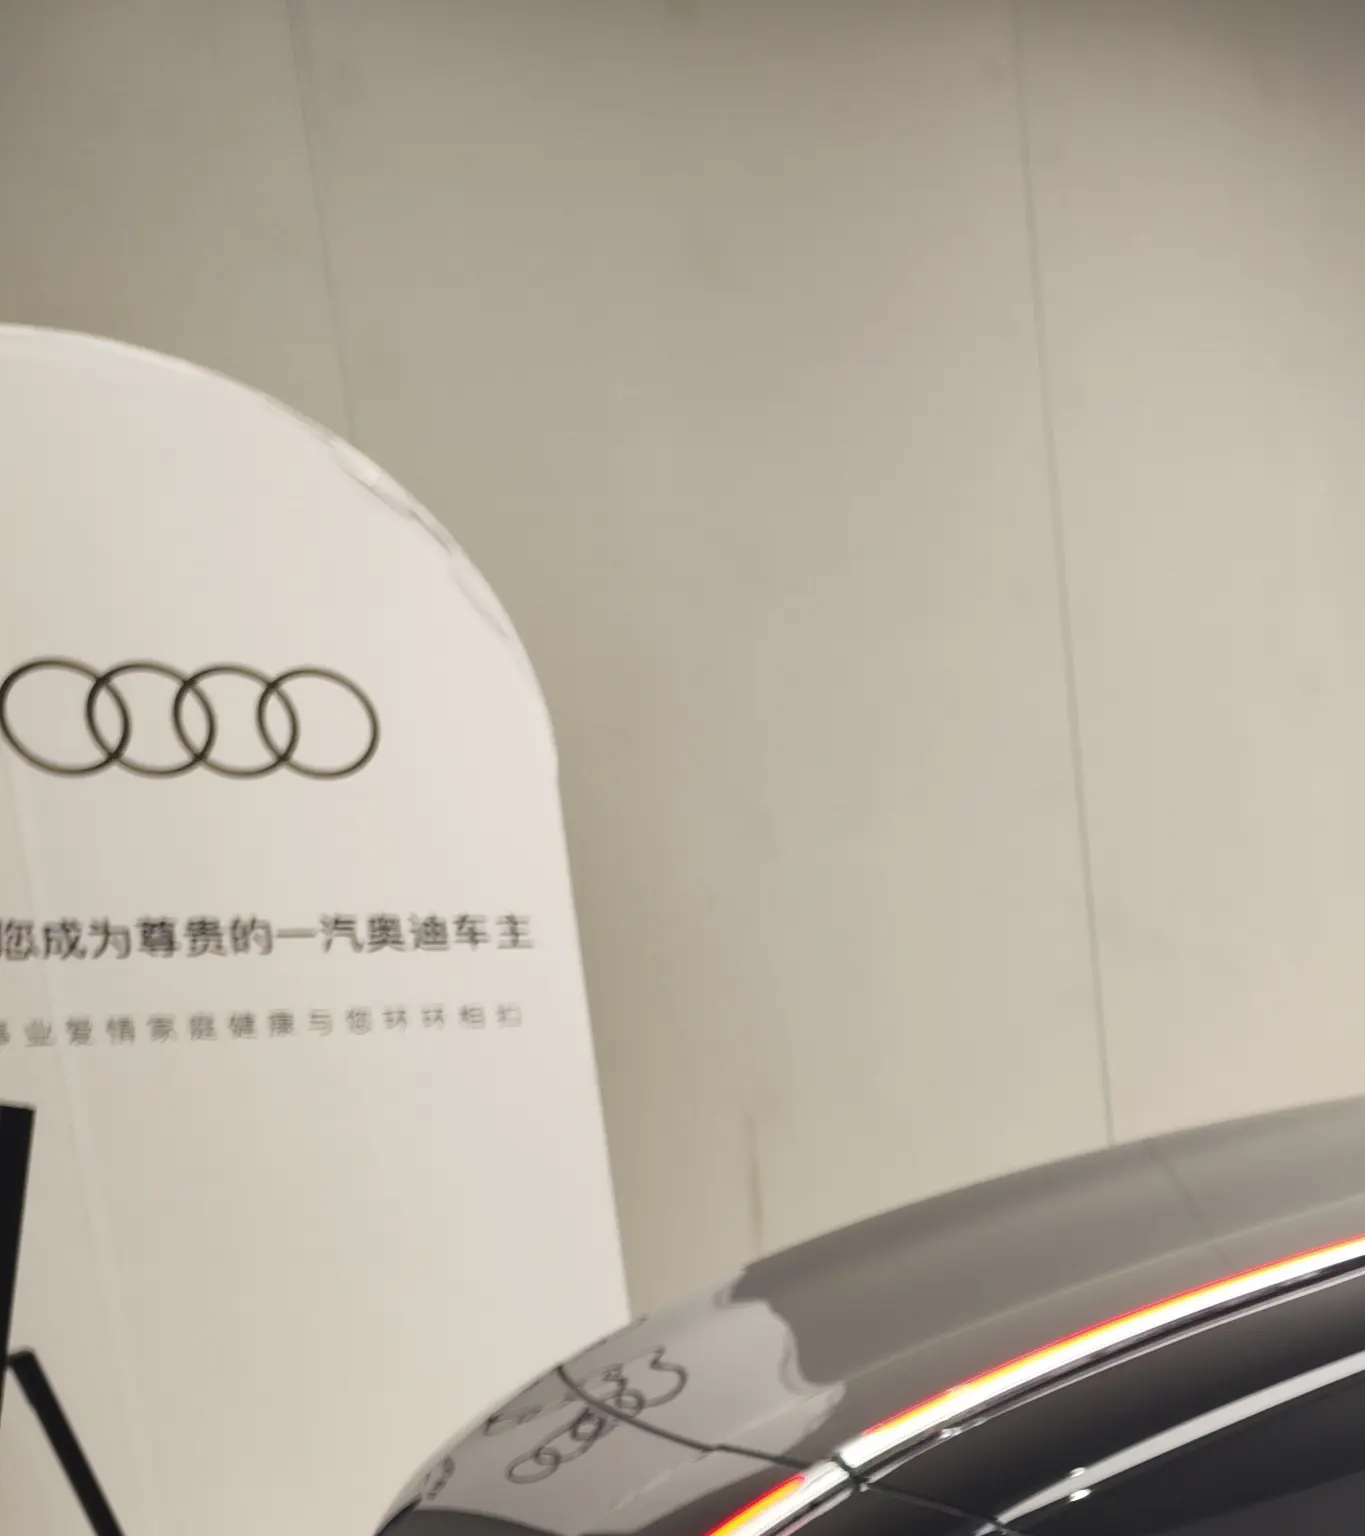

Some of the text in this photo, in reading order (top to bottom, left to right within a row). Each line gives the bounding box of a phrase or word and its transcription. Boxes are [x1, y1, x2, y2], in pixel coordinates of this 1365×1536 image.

[0, 914, 534, 961] 您成为尊贵的一汽奥迪车主
